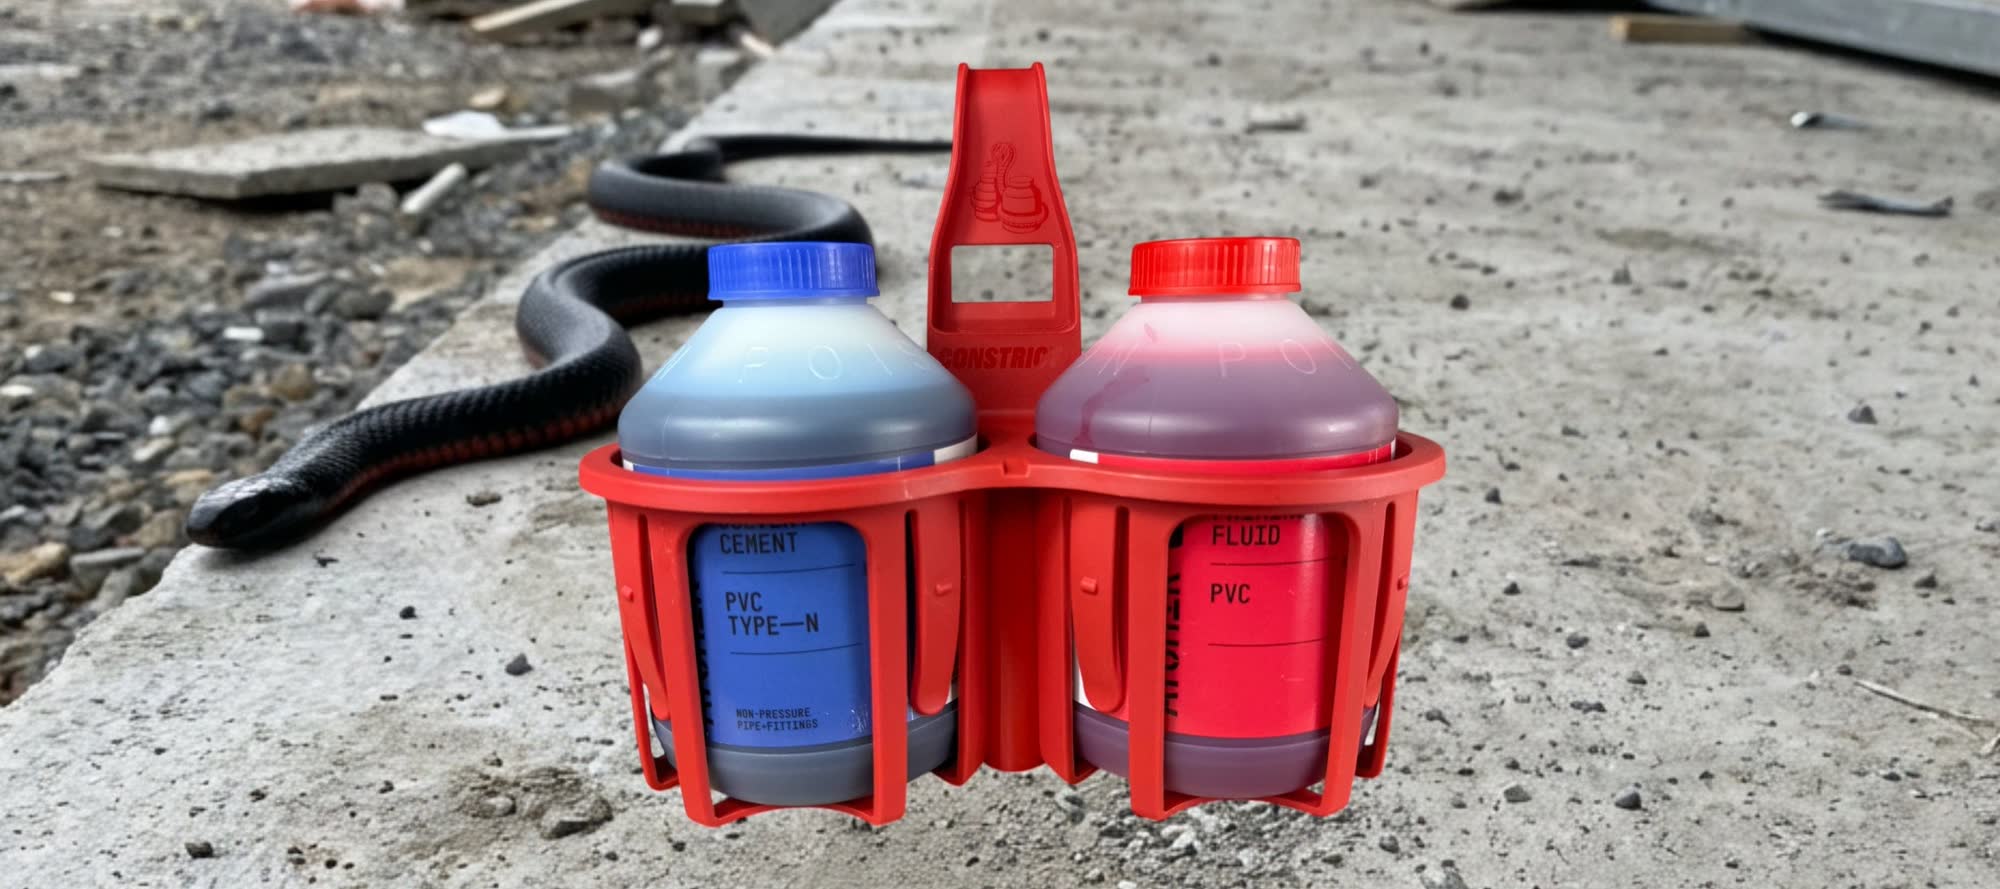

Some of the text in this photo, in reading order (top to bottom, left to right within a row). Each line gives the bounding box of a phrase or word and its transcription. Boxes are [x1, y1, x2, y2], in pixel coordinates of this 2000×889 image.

[940, 345, 1052, 370] CONSTRIC
[719, 531, 799, 555] CEMENT
[1211, 524, 1281, 547] FLUID
[724, 591, 763, 613] PVC
[1209, 582, 1251, 604] PVC
[735, 706, 812, 720] NON-PRESSURE
[736, 719, 819, 732] PIPE+FITTINGS
